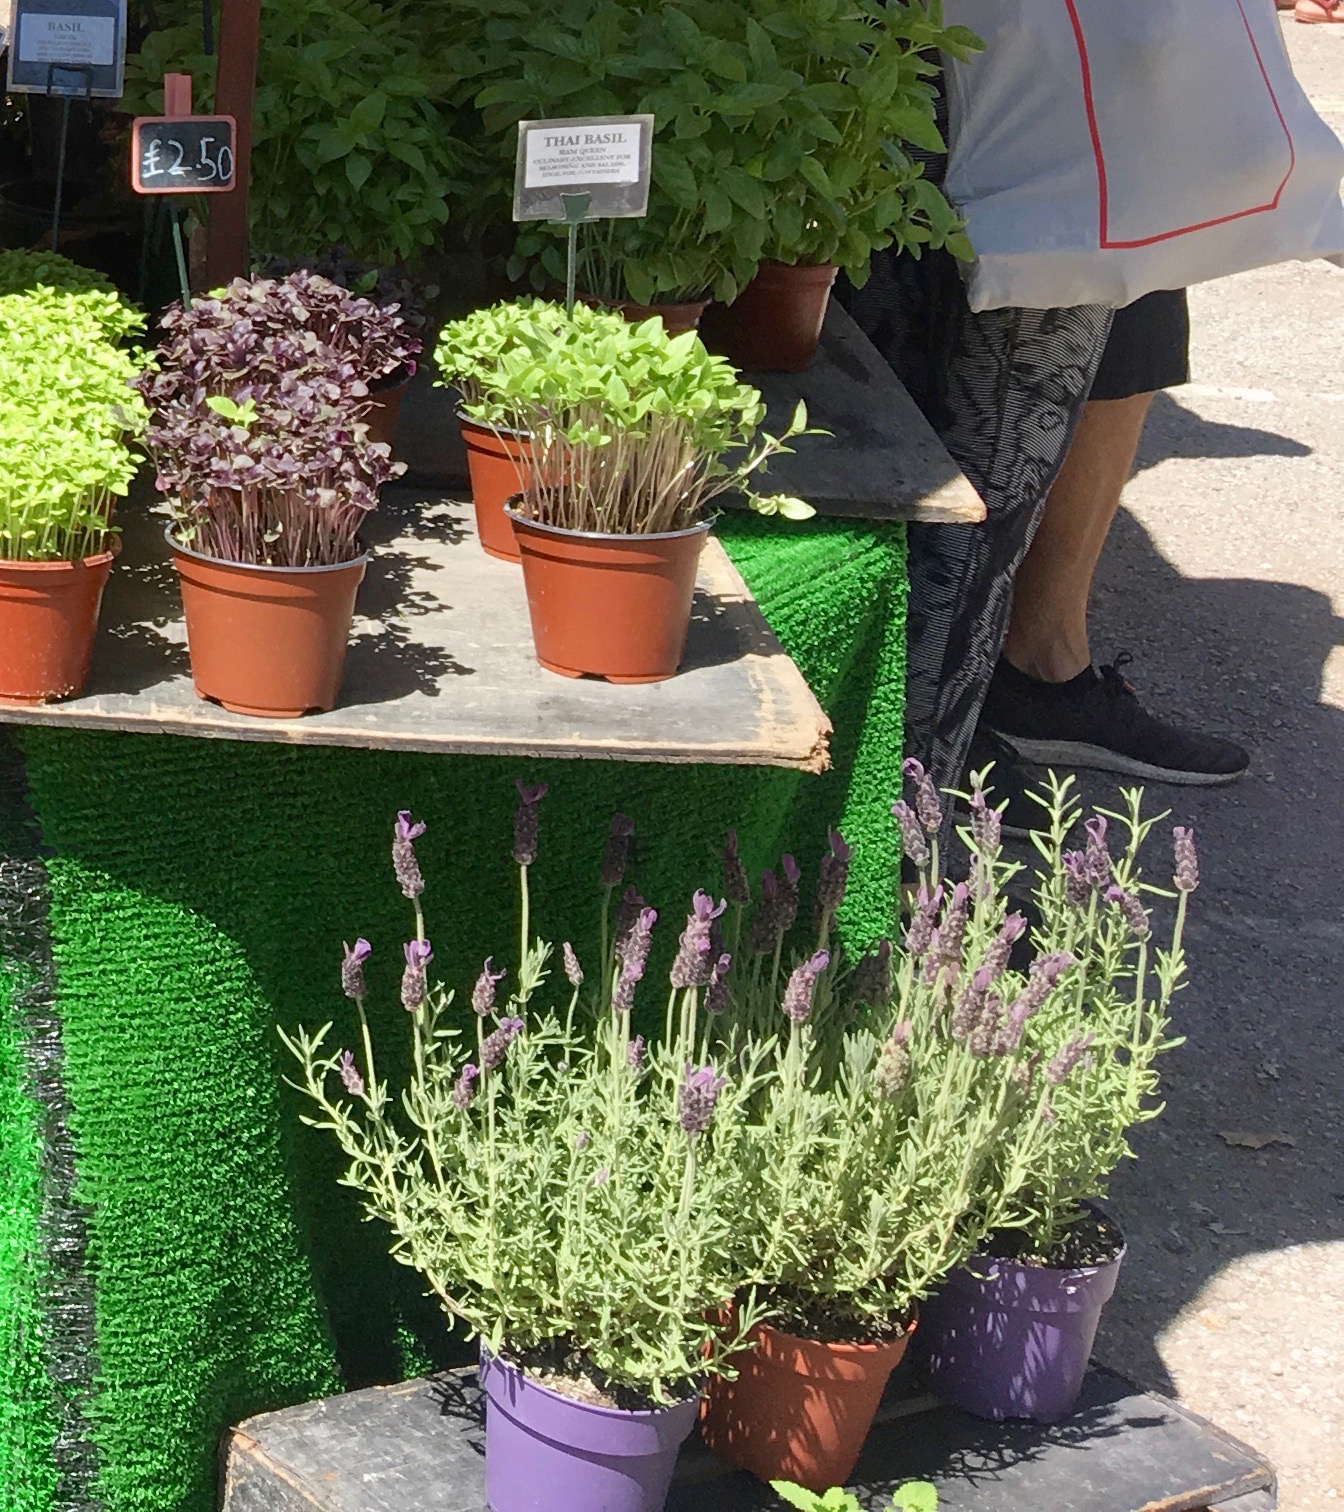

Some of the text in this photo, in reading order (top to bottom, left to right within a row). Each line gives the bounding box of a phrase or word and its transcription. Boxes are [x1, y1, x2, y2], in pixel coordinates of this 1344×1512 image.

[48, 22, 85, 32] BASIL
[543, 133, 627, 147] THAI BASIL
[579, 147, 607, 155] QUEEN
[142, 137, 234, 181] £2.50
